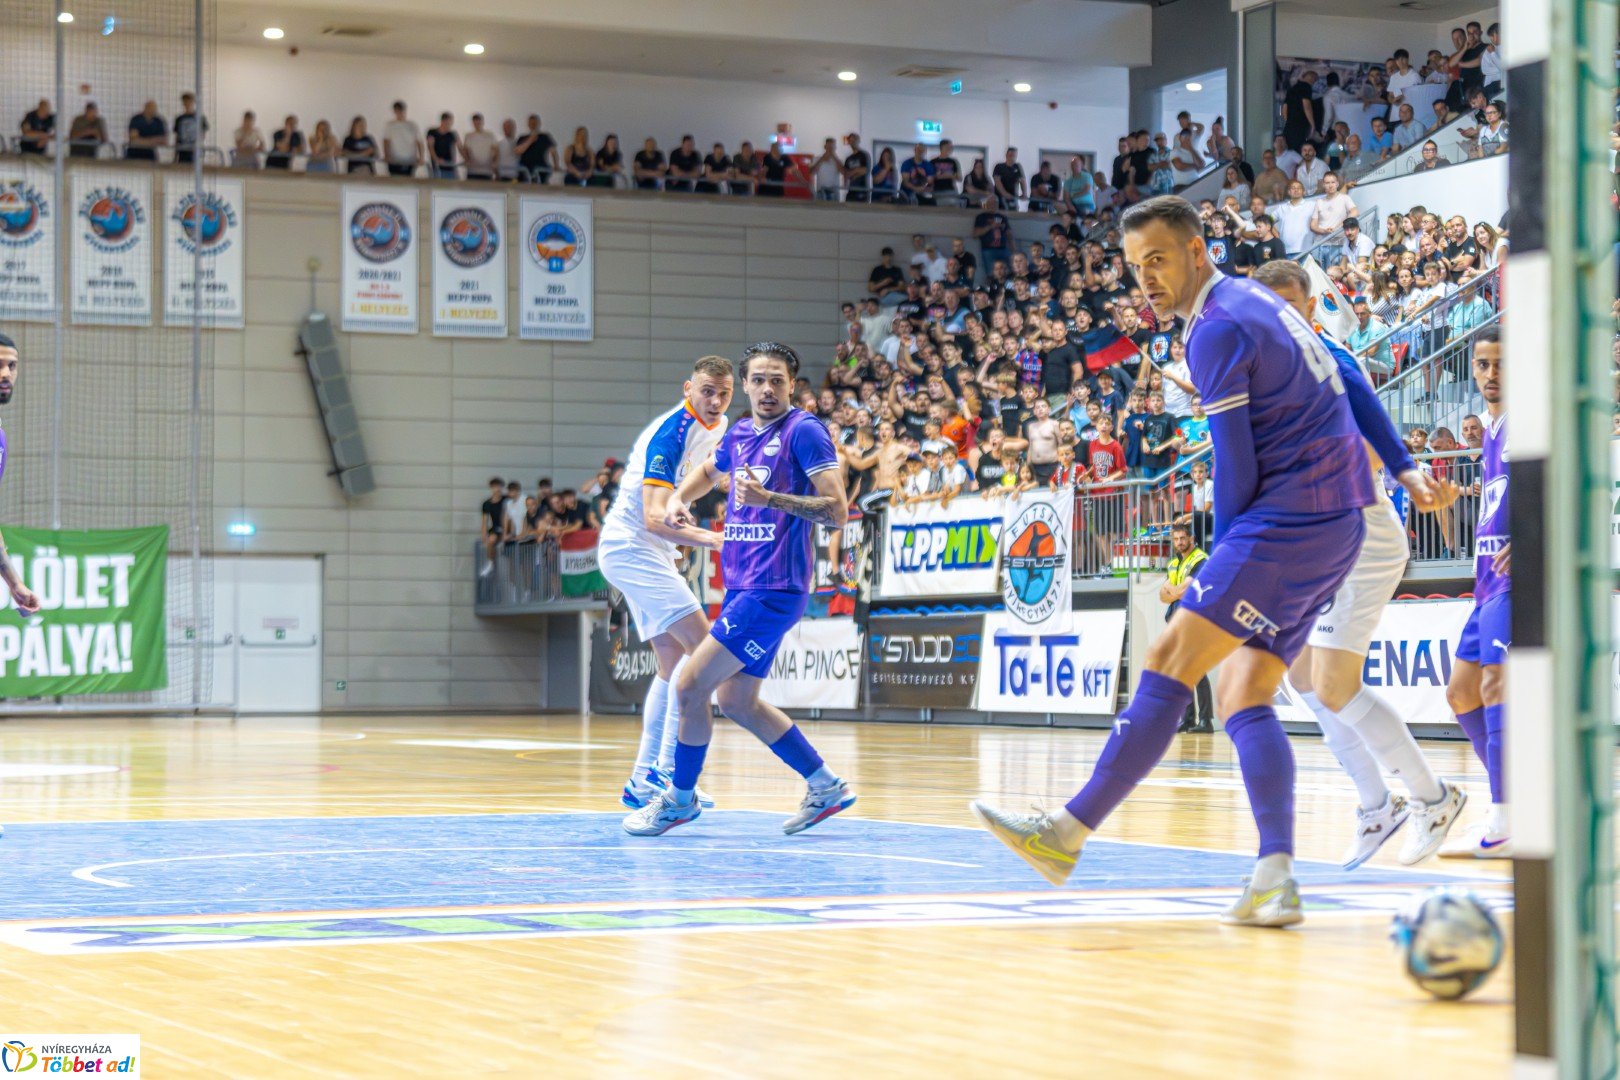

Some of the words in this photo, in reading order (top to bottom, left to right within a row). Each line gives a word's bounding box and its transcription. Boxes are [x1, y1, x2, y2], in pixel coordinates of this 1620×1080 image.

[0, 616, 134, 677] PÁLYA!
[804, 648, 860, 680] PINCE
[1082, 668, 1112, 698] KFT
